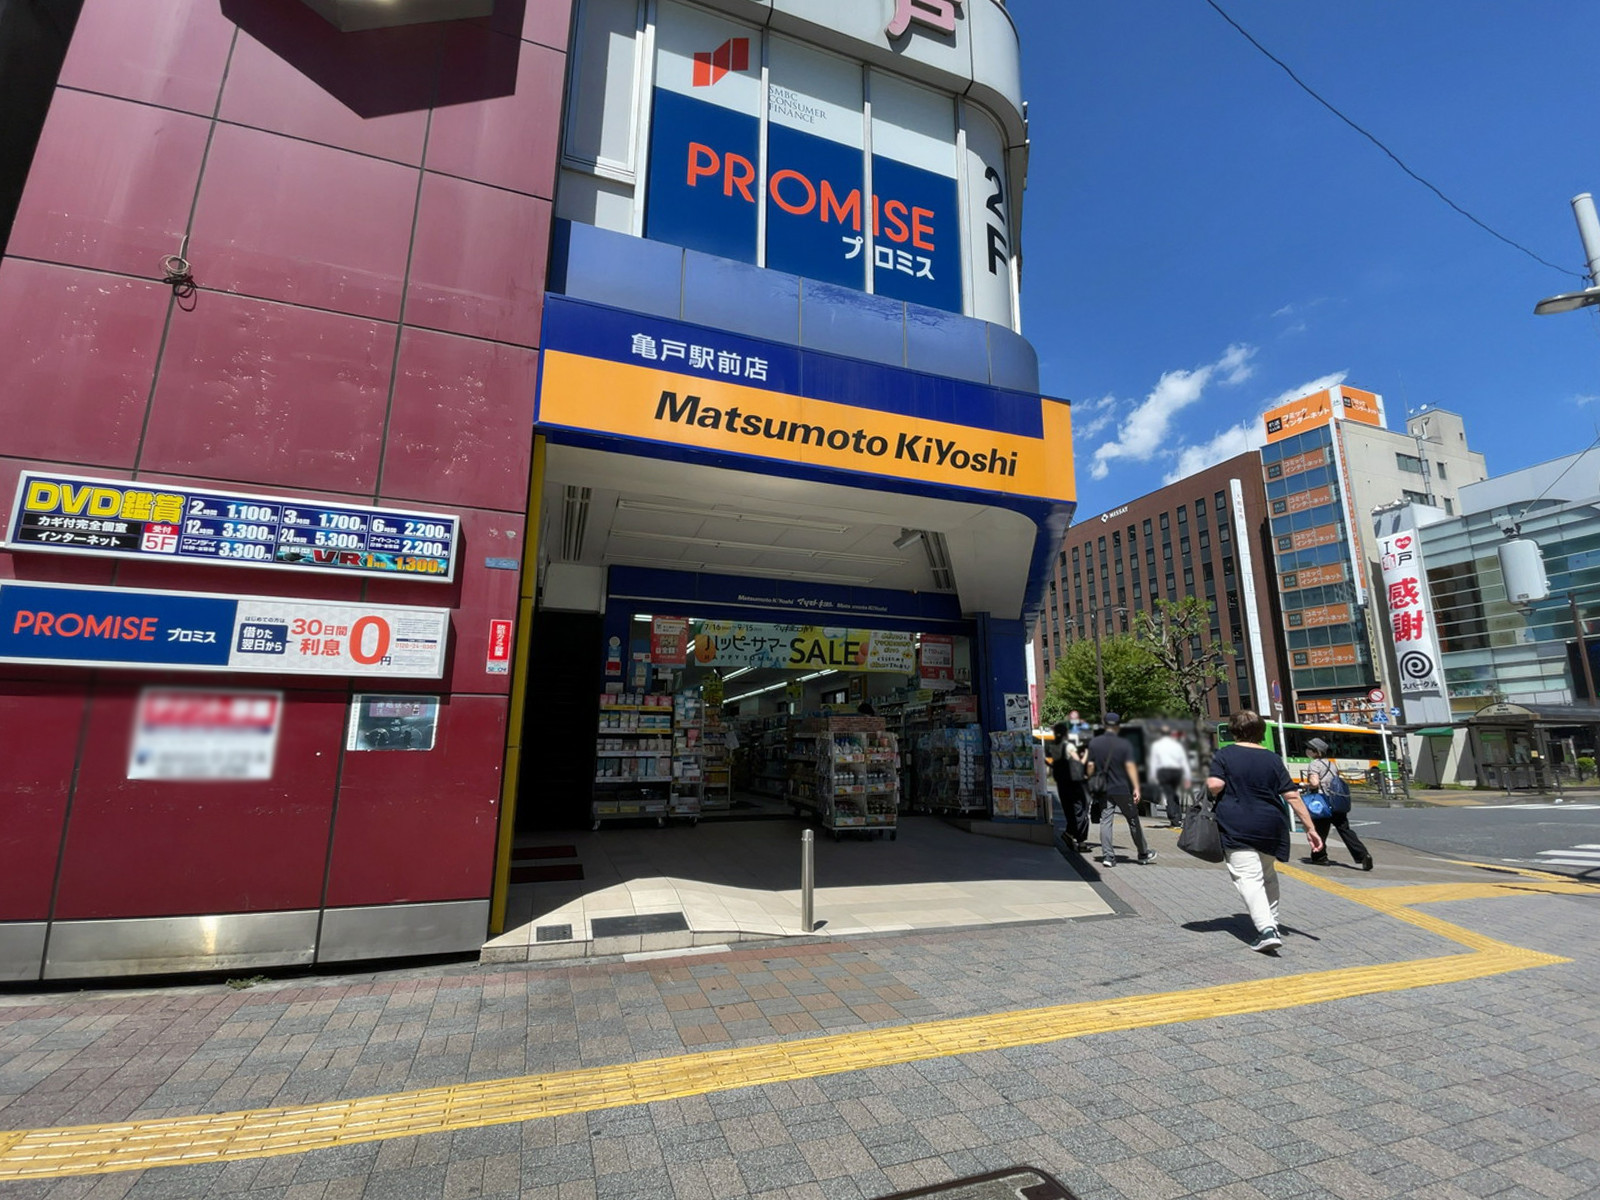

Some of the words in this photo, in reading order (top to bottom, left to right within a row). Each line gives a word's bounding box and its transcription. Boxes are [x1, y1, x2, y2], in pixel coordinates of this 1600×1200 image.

[769, 85, 798, 101] SMBC
[769, 95, 827, 120] CONSUMER
[769, 103, 815, 124] FINANCE
[686, 141, 935, 252] PROMISE
[842, 236, 935, 280] プロミス
[631, 332, 768, 382] 亀戸駅前店
[1282, 408, 1308, 420] コミック
[655, 390, 888, 457] Matsumoto
[895, 433, 1018, 477] KiYoshi
[25, 481, 186, 524] DVD鑑賞
[227, 504, 277, 522] 1,100円
[319, 513, 367, 531] 1,700円
[38, 516, 128, 533] カギ付完全個室
[152, 526, 172, 534] 受付
[37, 532, 120, 546] インターネット
[145, 535, 176, 551] 5F
[313, 548, 362, 566] VR
[1388, 577, 1424, 644] 感謝
[13, 610, 159, 641] PROMISE
[243, 626, 273, 639] 借りた
[291, 618, 348, 637] 30日間
[167, 628, 216, 643] プロミス
[241, 638, 283, 652] 翌日から
[300, 638, 341, 656] 利息
[704, 635, 787, 652] ハッピーサマー
[789, 637, 861, 666] SALE
[1402, 681, 1438, 690] スパークル
